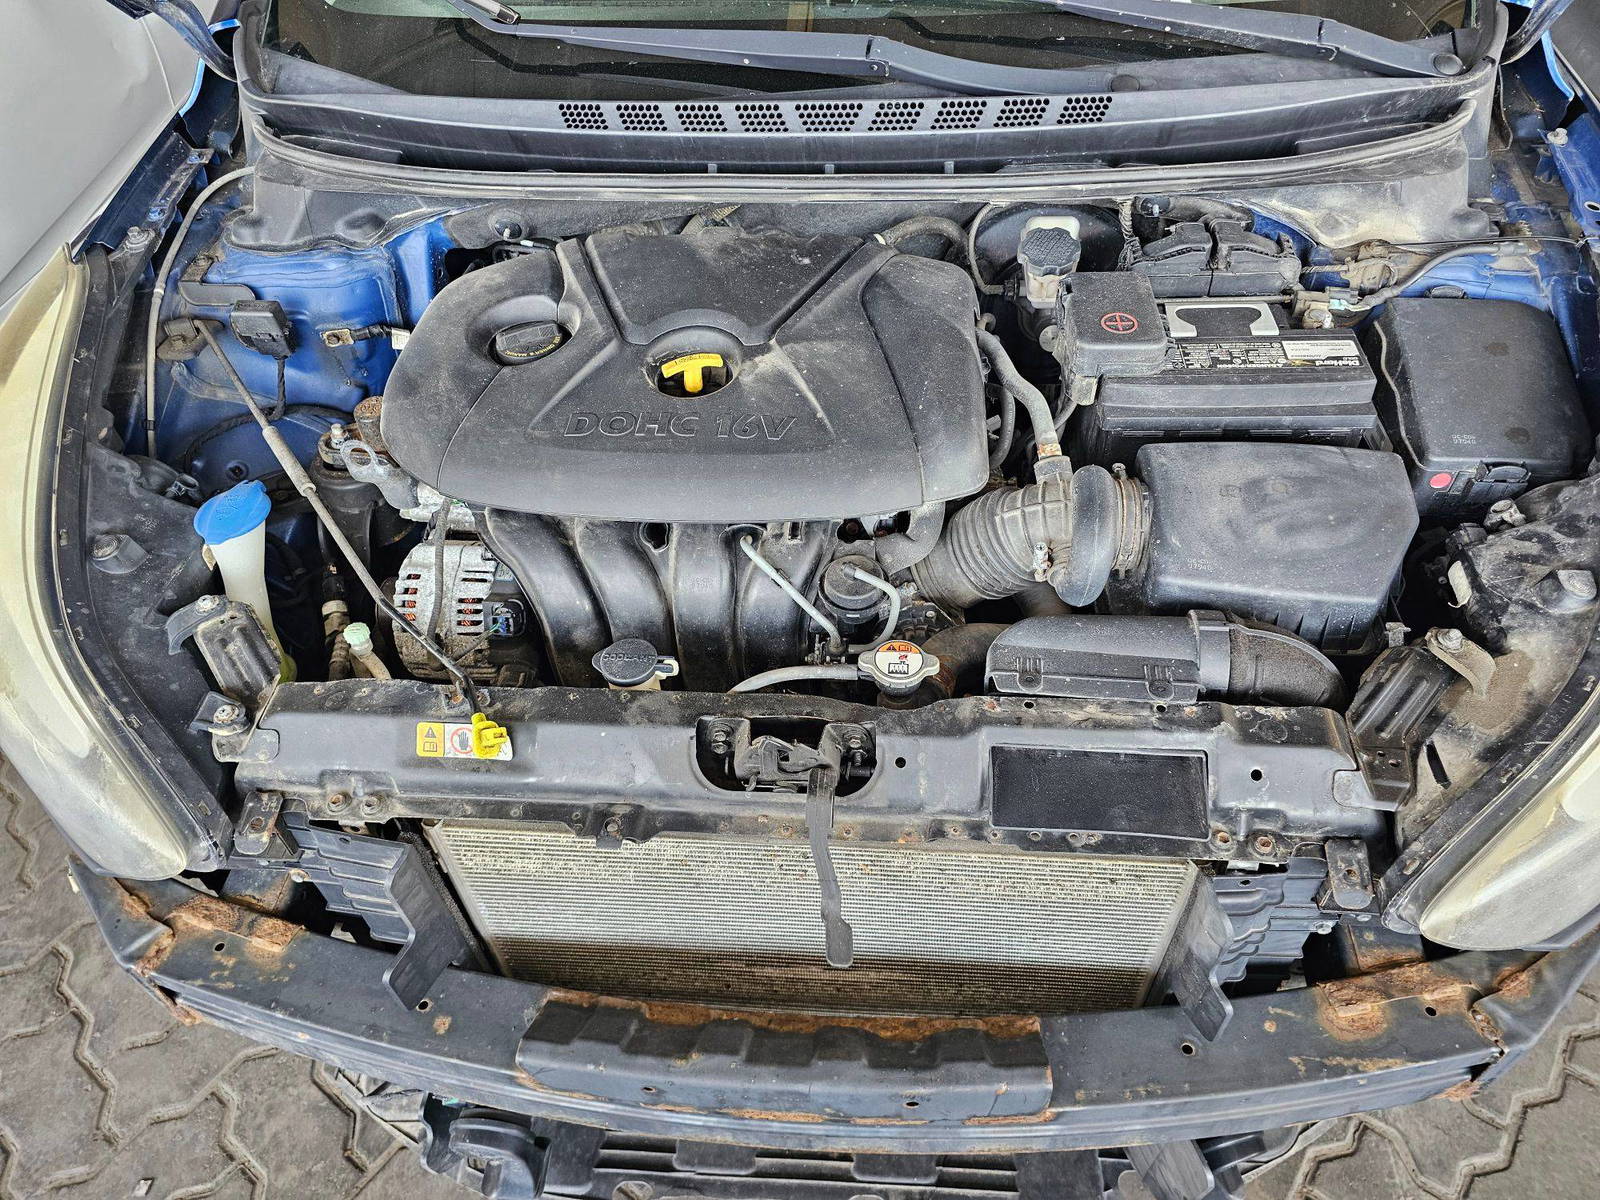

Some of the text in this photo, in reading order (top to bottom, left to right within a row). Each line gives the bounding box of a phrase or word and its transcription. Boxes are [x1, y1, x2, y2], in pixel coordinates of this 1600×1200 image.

[563, 412, 798, 441] DOHC 16V
[602, 653, 656, 663] COOLANT
